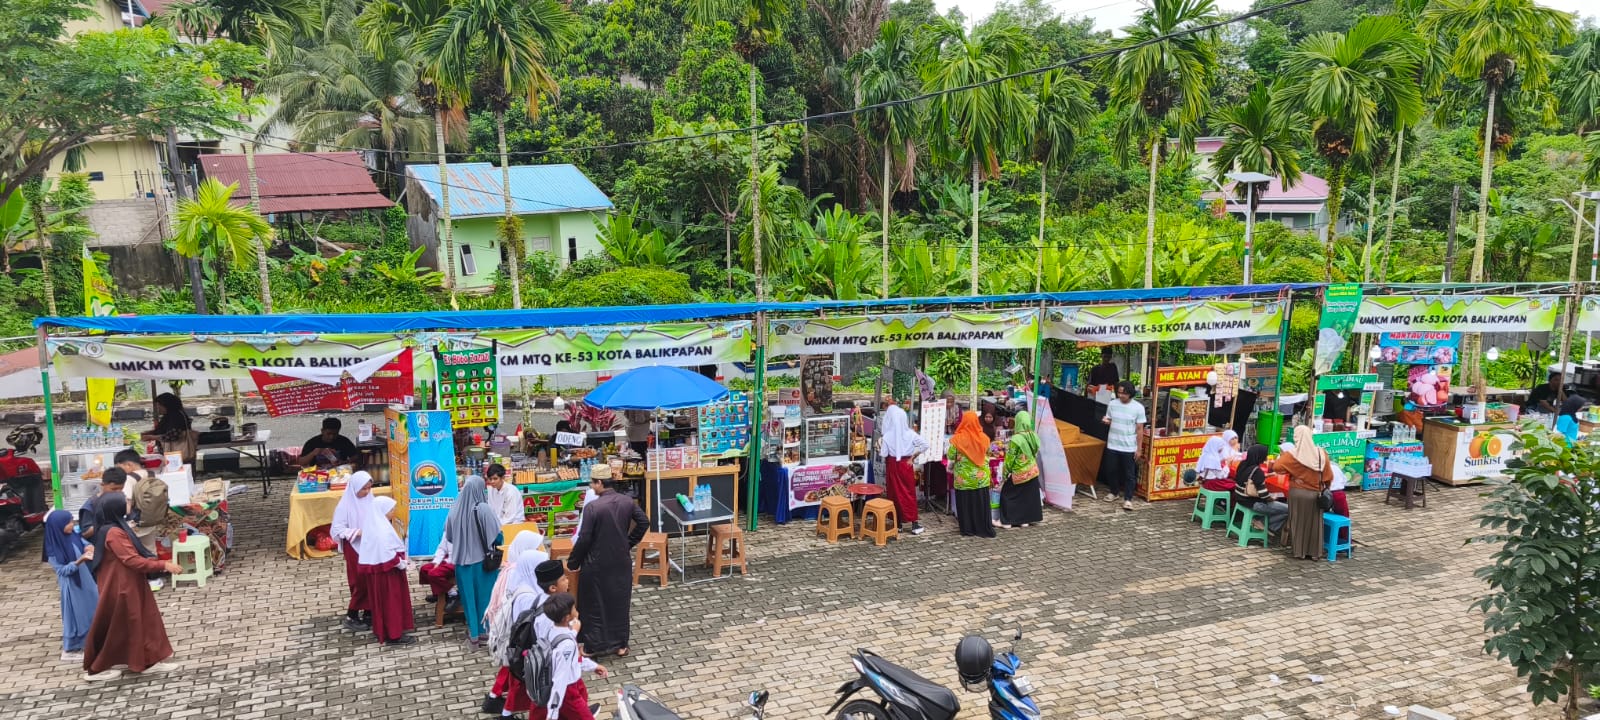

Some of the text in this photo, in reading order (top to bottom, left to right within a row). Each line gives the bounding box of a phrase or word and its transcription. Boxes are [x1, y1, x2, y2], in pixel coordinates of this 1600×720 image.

[1359, 315, 1527, 325] UMKM MTQ KE-53 KOTA BALIKPAPAN
[1074, 319, 1251, 335] UMKM MTQ KE-53 KOTA BALIKPAPAN
[804, 331, 1004, 346] UMKM MTQ KE-53 KOTA BALIKPAPAN
[522, 354, 552, 366] MTQ
[555, 352, 593, 364] KE-53
[596, 349, 632, 361] KOTA
[635, 346, 713, 359] BALIKPAPAN
[108, 360, 163, 371] UMKM
[168, 359, 205, 371] MTQ
[261, 358, 305, 368] KOTA
[1159, 371, 1175, 382] MIE
[1176, 370, 1201, 381] AYAM
[1333, 437, 1361, 448] LIMAU
[1464, 455, 1501, 468] Sunkist
[523, 494, 562, 508] AZI
